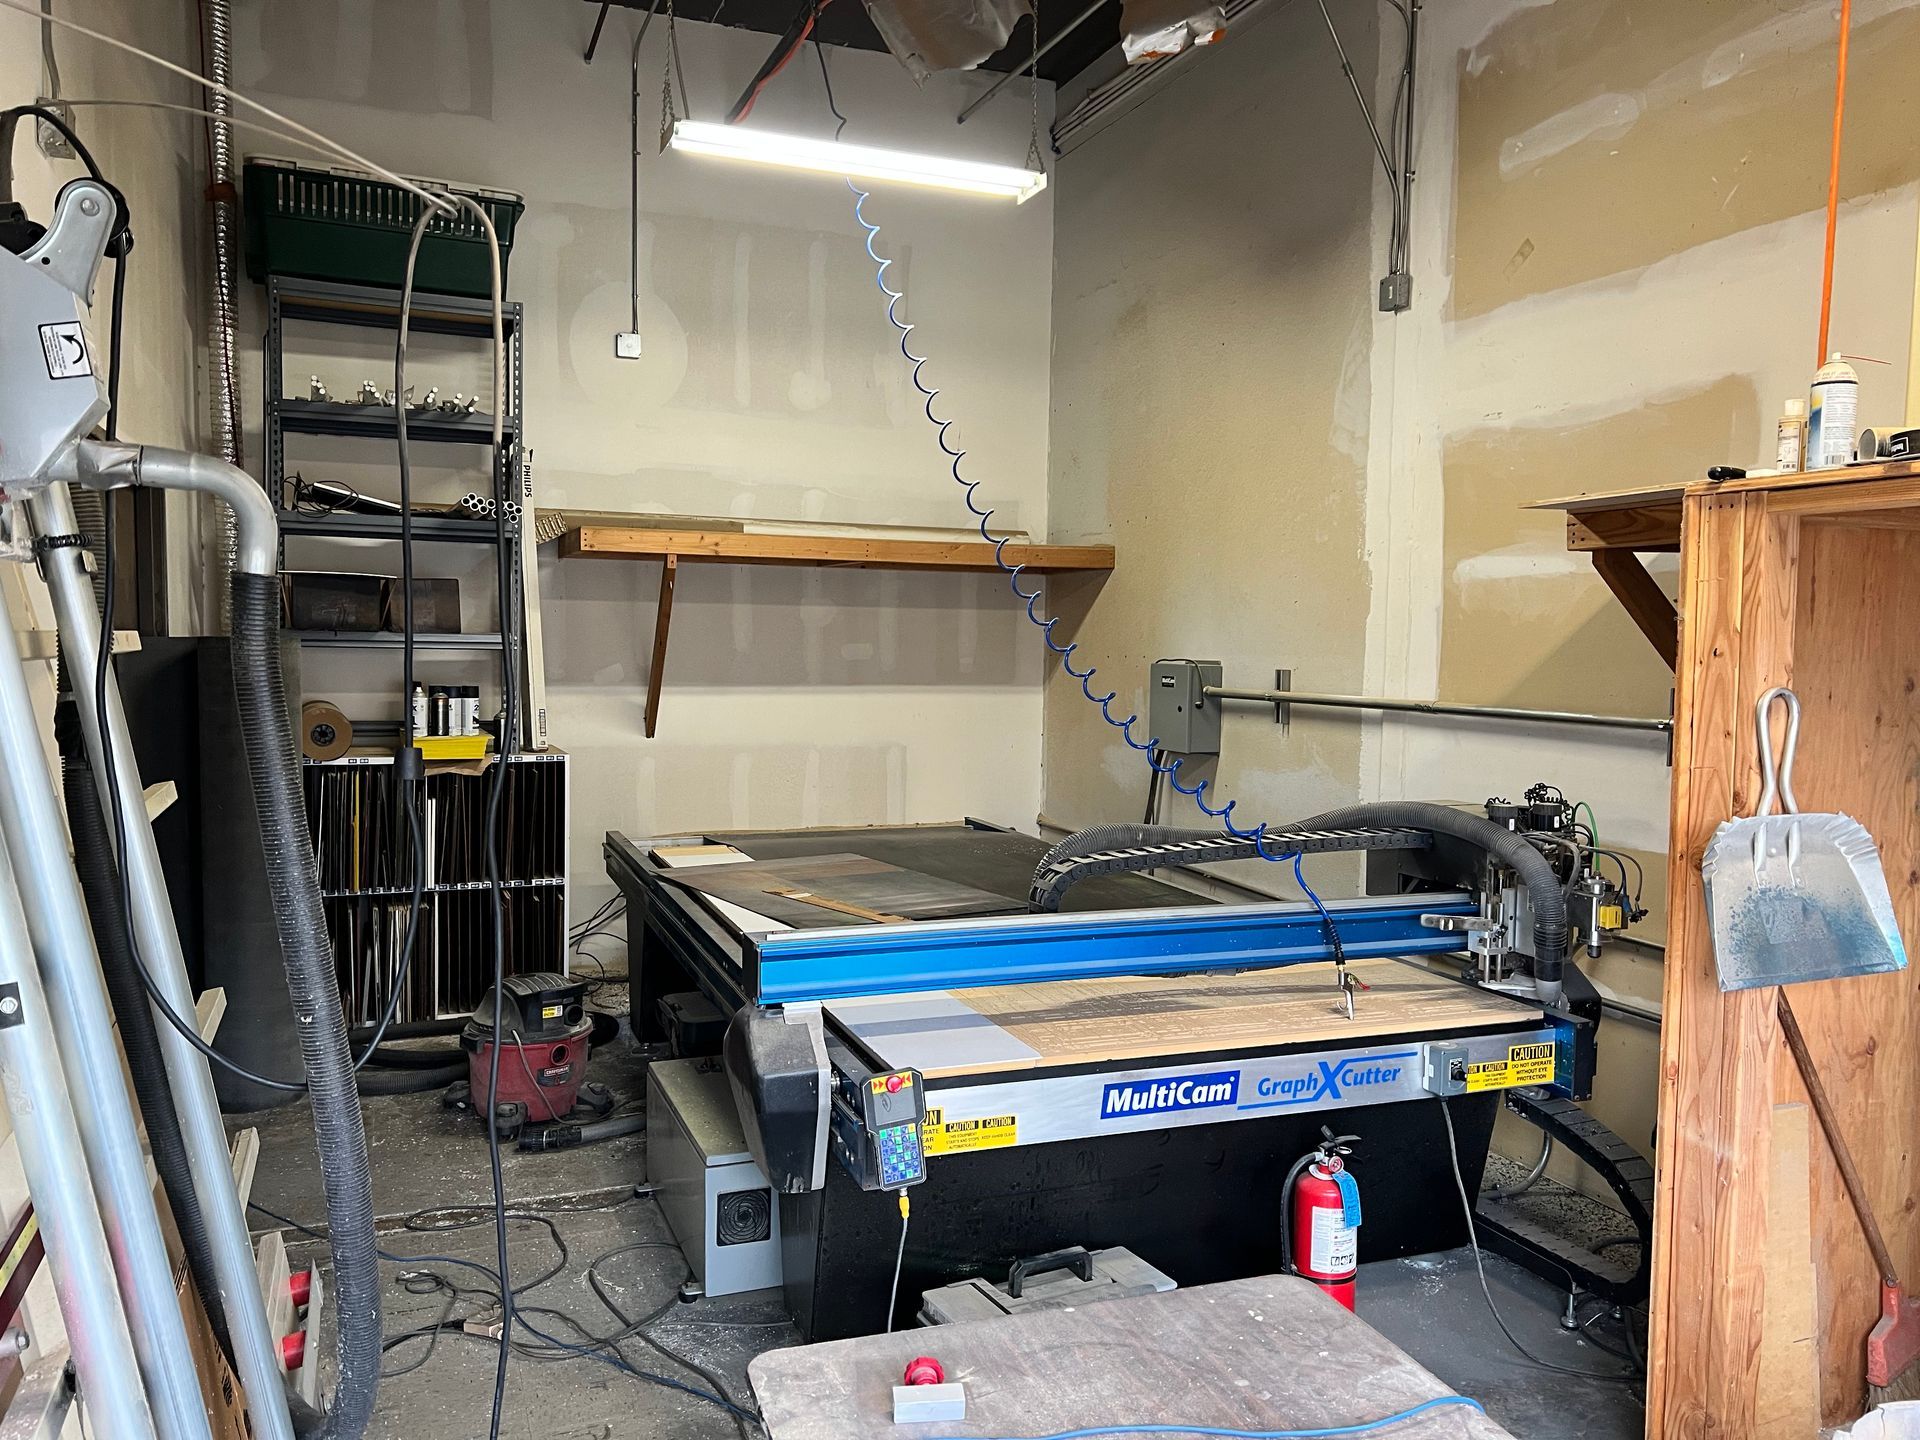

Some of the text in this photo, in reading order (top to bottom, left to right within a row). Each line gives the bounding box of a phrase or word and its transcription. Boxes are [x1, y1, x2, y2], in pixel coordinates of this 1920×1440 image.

[523, 465, 533, 498] PHILIPS
[1514, 1045, 1550, 1061] CAUTION
[1485, 1063, 1505, 1072] CAUTION
[1106, 1080, 1232, 1114] MultiCam
[949, 1120, 976, 1132] CAUTION
[986, 1117, 1011, 1128] CAUTION
